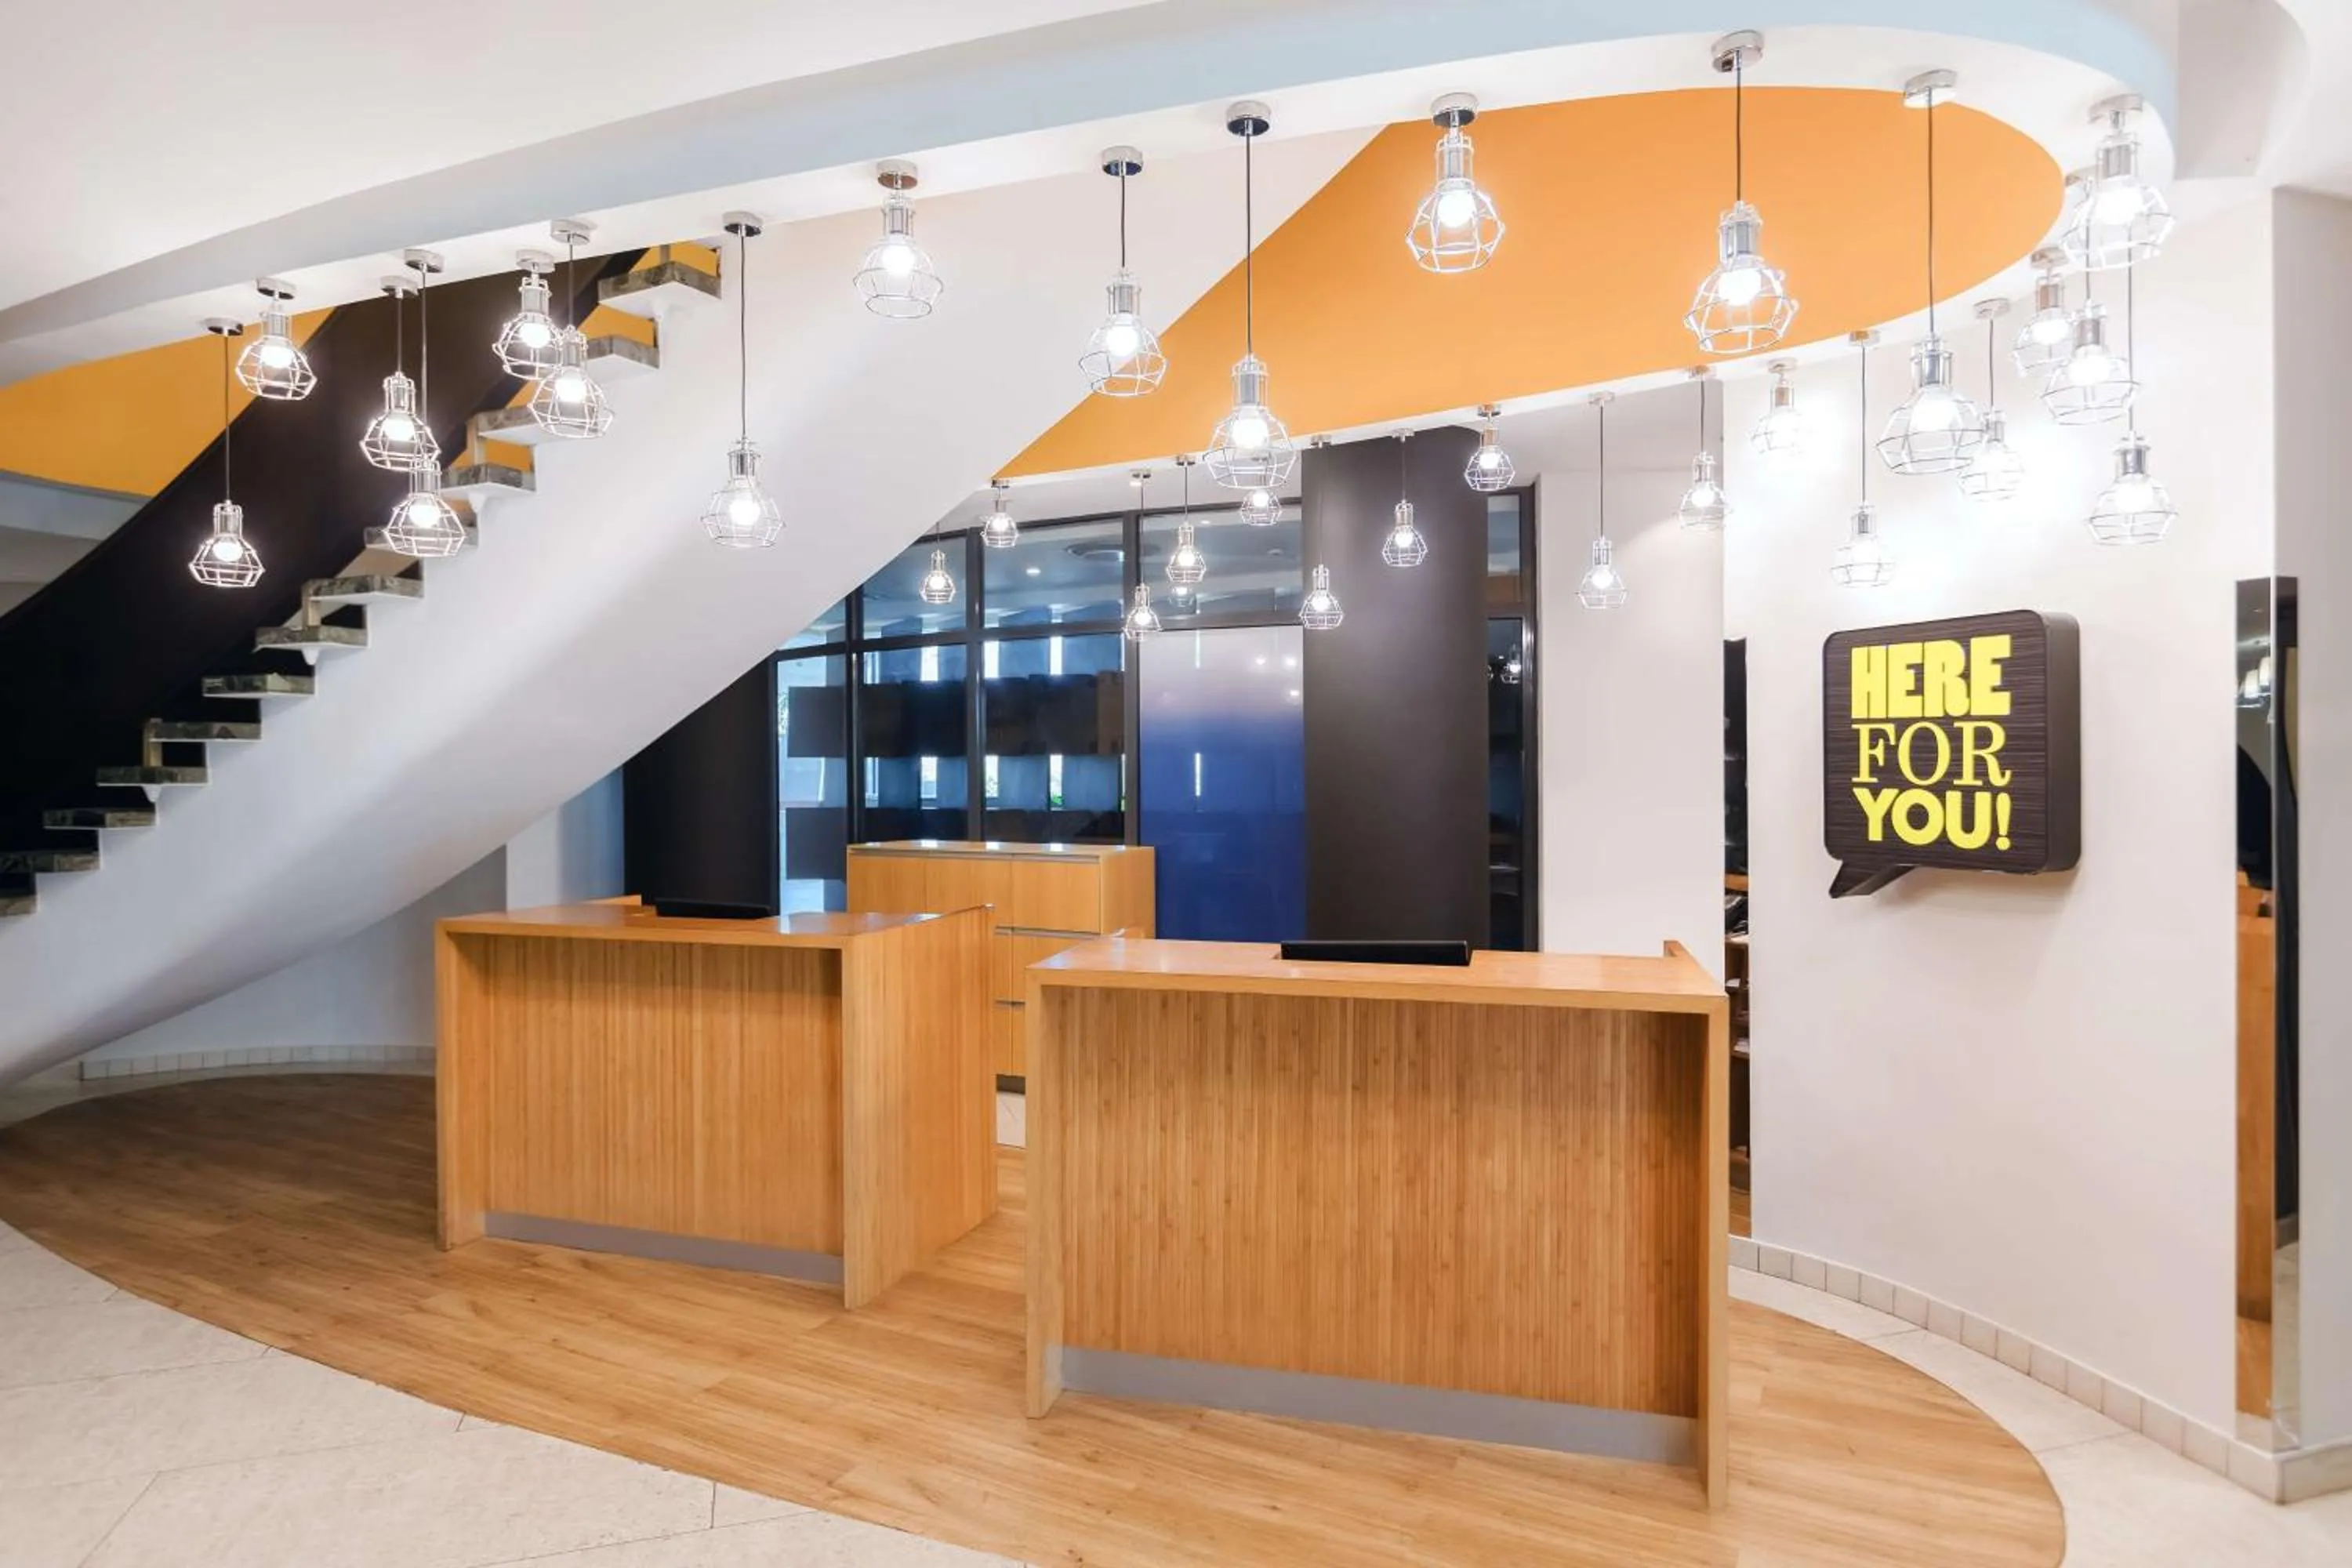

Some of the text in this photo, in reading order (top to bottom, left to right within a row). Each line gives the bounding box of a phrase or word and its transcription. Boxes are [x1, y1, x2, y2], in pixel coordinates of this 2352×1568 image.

[1851, 634, 2011, 719] HERE
[1851, 720, 2012, 787] FOR
[1852, 787, 2012, 851] YOU!
